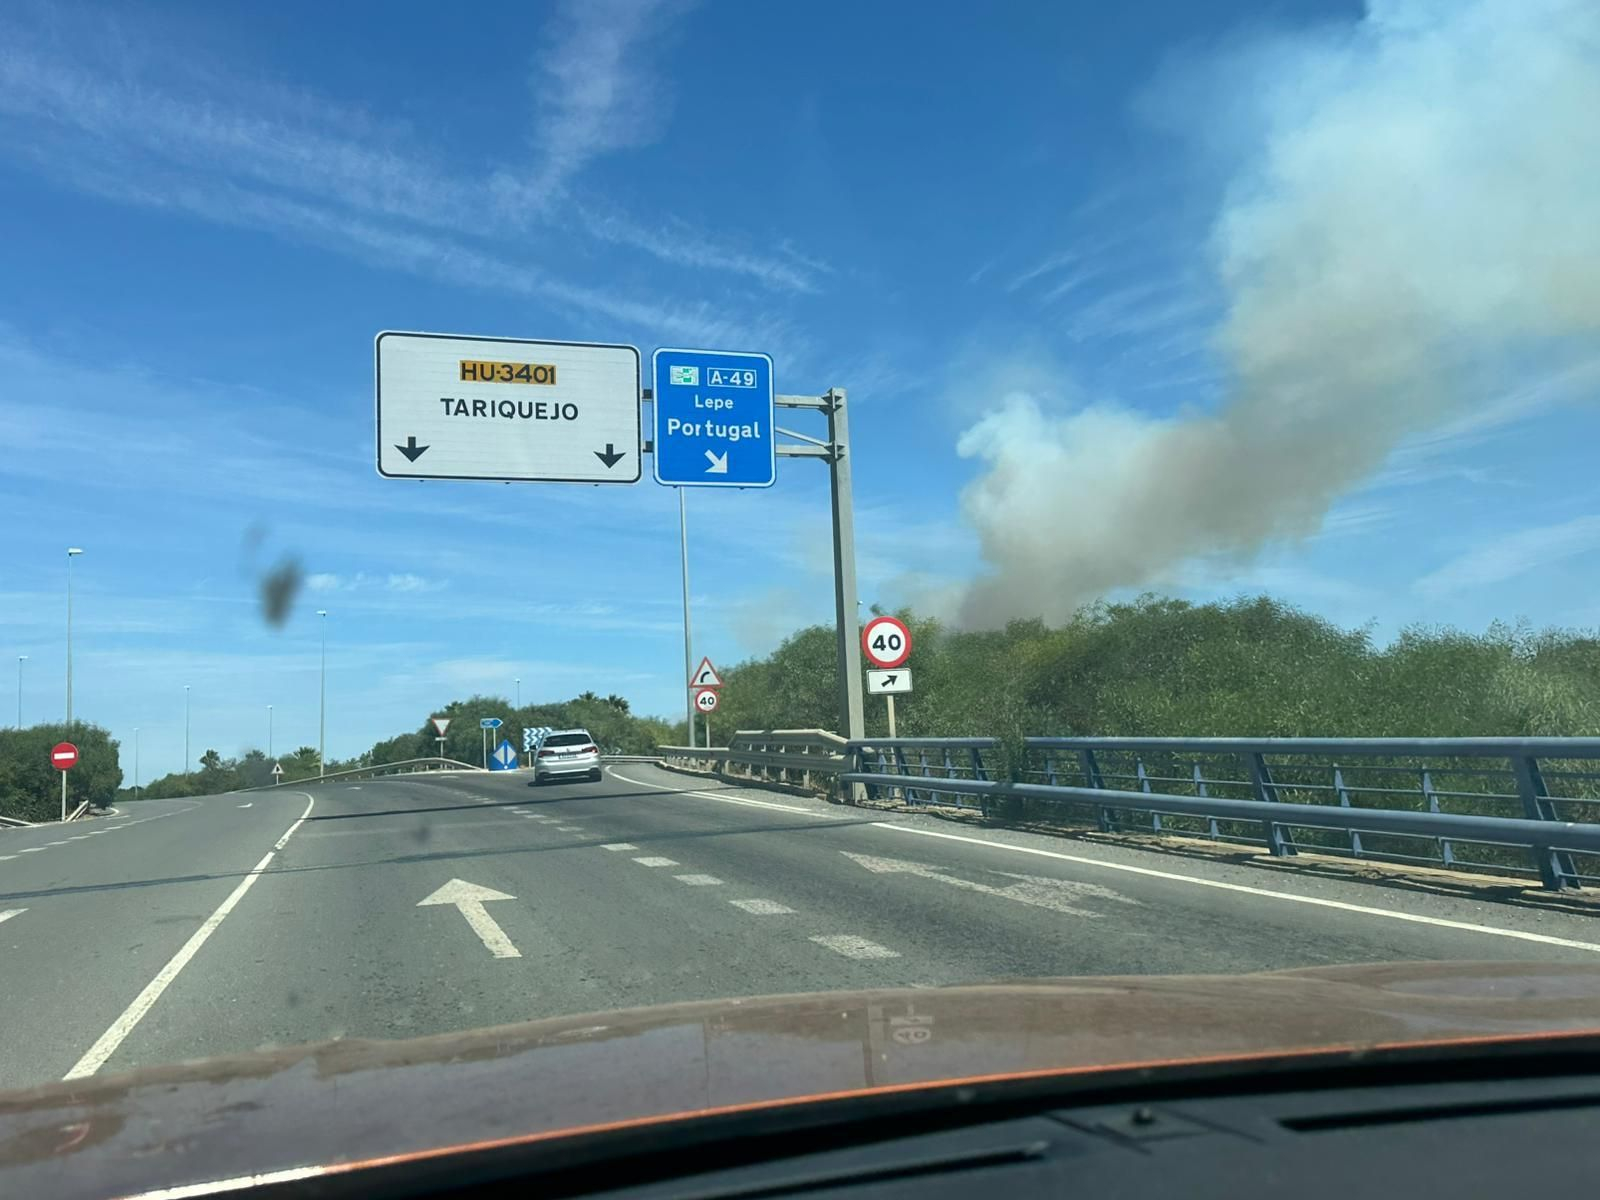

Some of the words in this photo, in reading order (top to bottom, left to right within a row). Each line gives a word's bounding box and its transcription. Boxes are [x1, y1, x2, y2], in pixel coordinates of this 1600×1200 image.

[461, 363, 555, 384] HU-3401
[711, 371, 754, 386] A-49
[440, 398, 578, 421] TARIQUEJO
[695, 394, 734, 410] Lepe
[668, 418, 760, 441] Portugal
[872, 634, 901, 651] 40
[700, 697, 715, 705] 40
